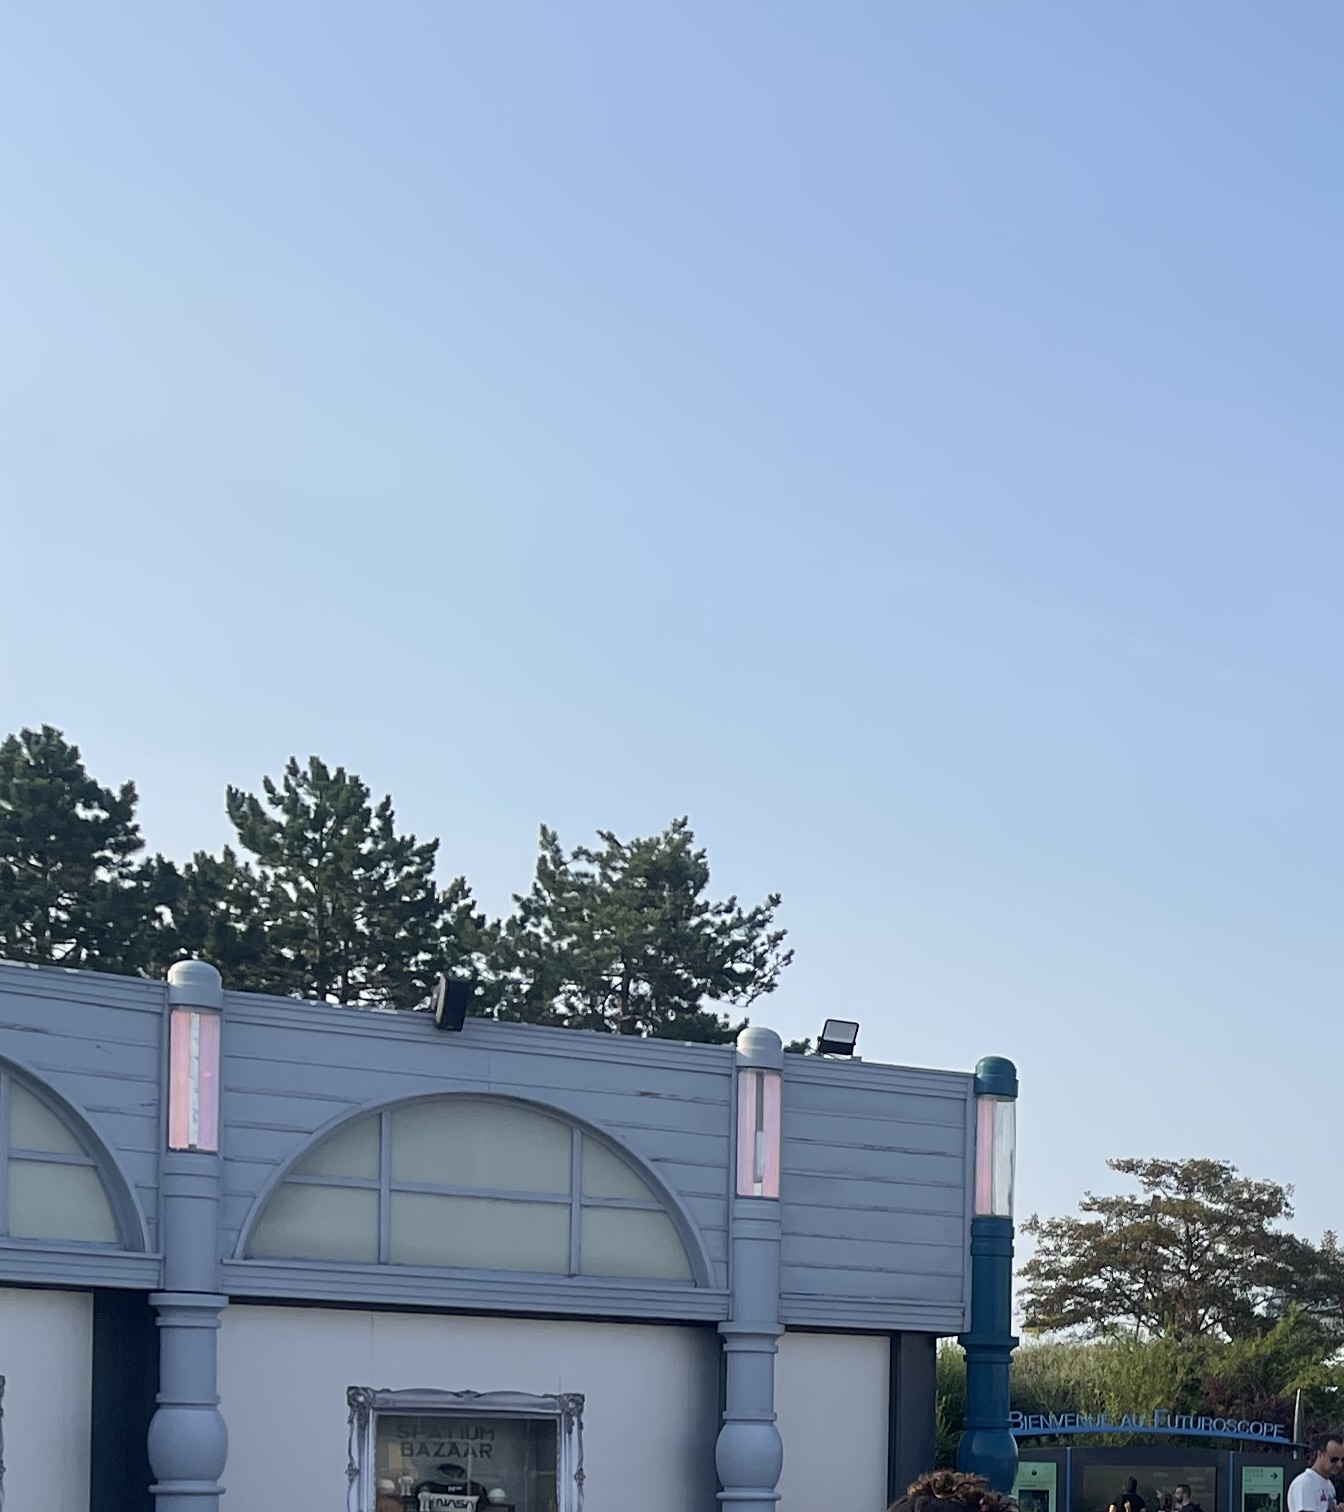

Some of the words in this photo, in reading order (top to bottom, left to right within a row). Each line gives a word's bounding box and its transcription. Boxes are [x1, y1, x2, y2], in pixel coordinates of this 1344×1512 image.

[1009, 1411, 1111, 1431] BIENVENUE
[1120, 1413, 1146, 1429] AU
[1154, 1408, 1286, 1438] FUTUROSCOPE
[400, 1441, 493, 1459] BAZAAR
[436, 1498, 474, 1510] NASA
